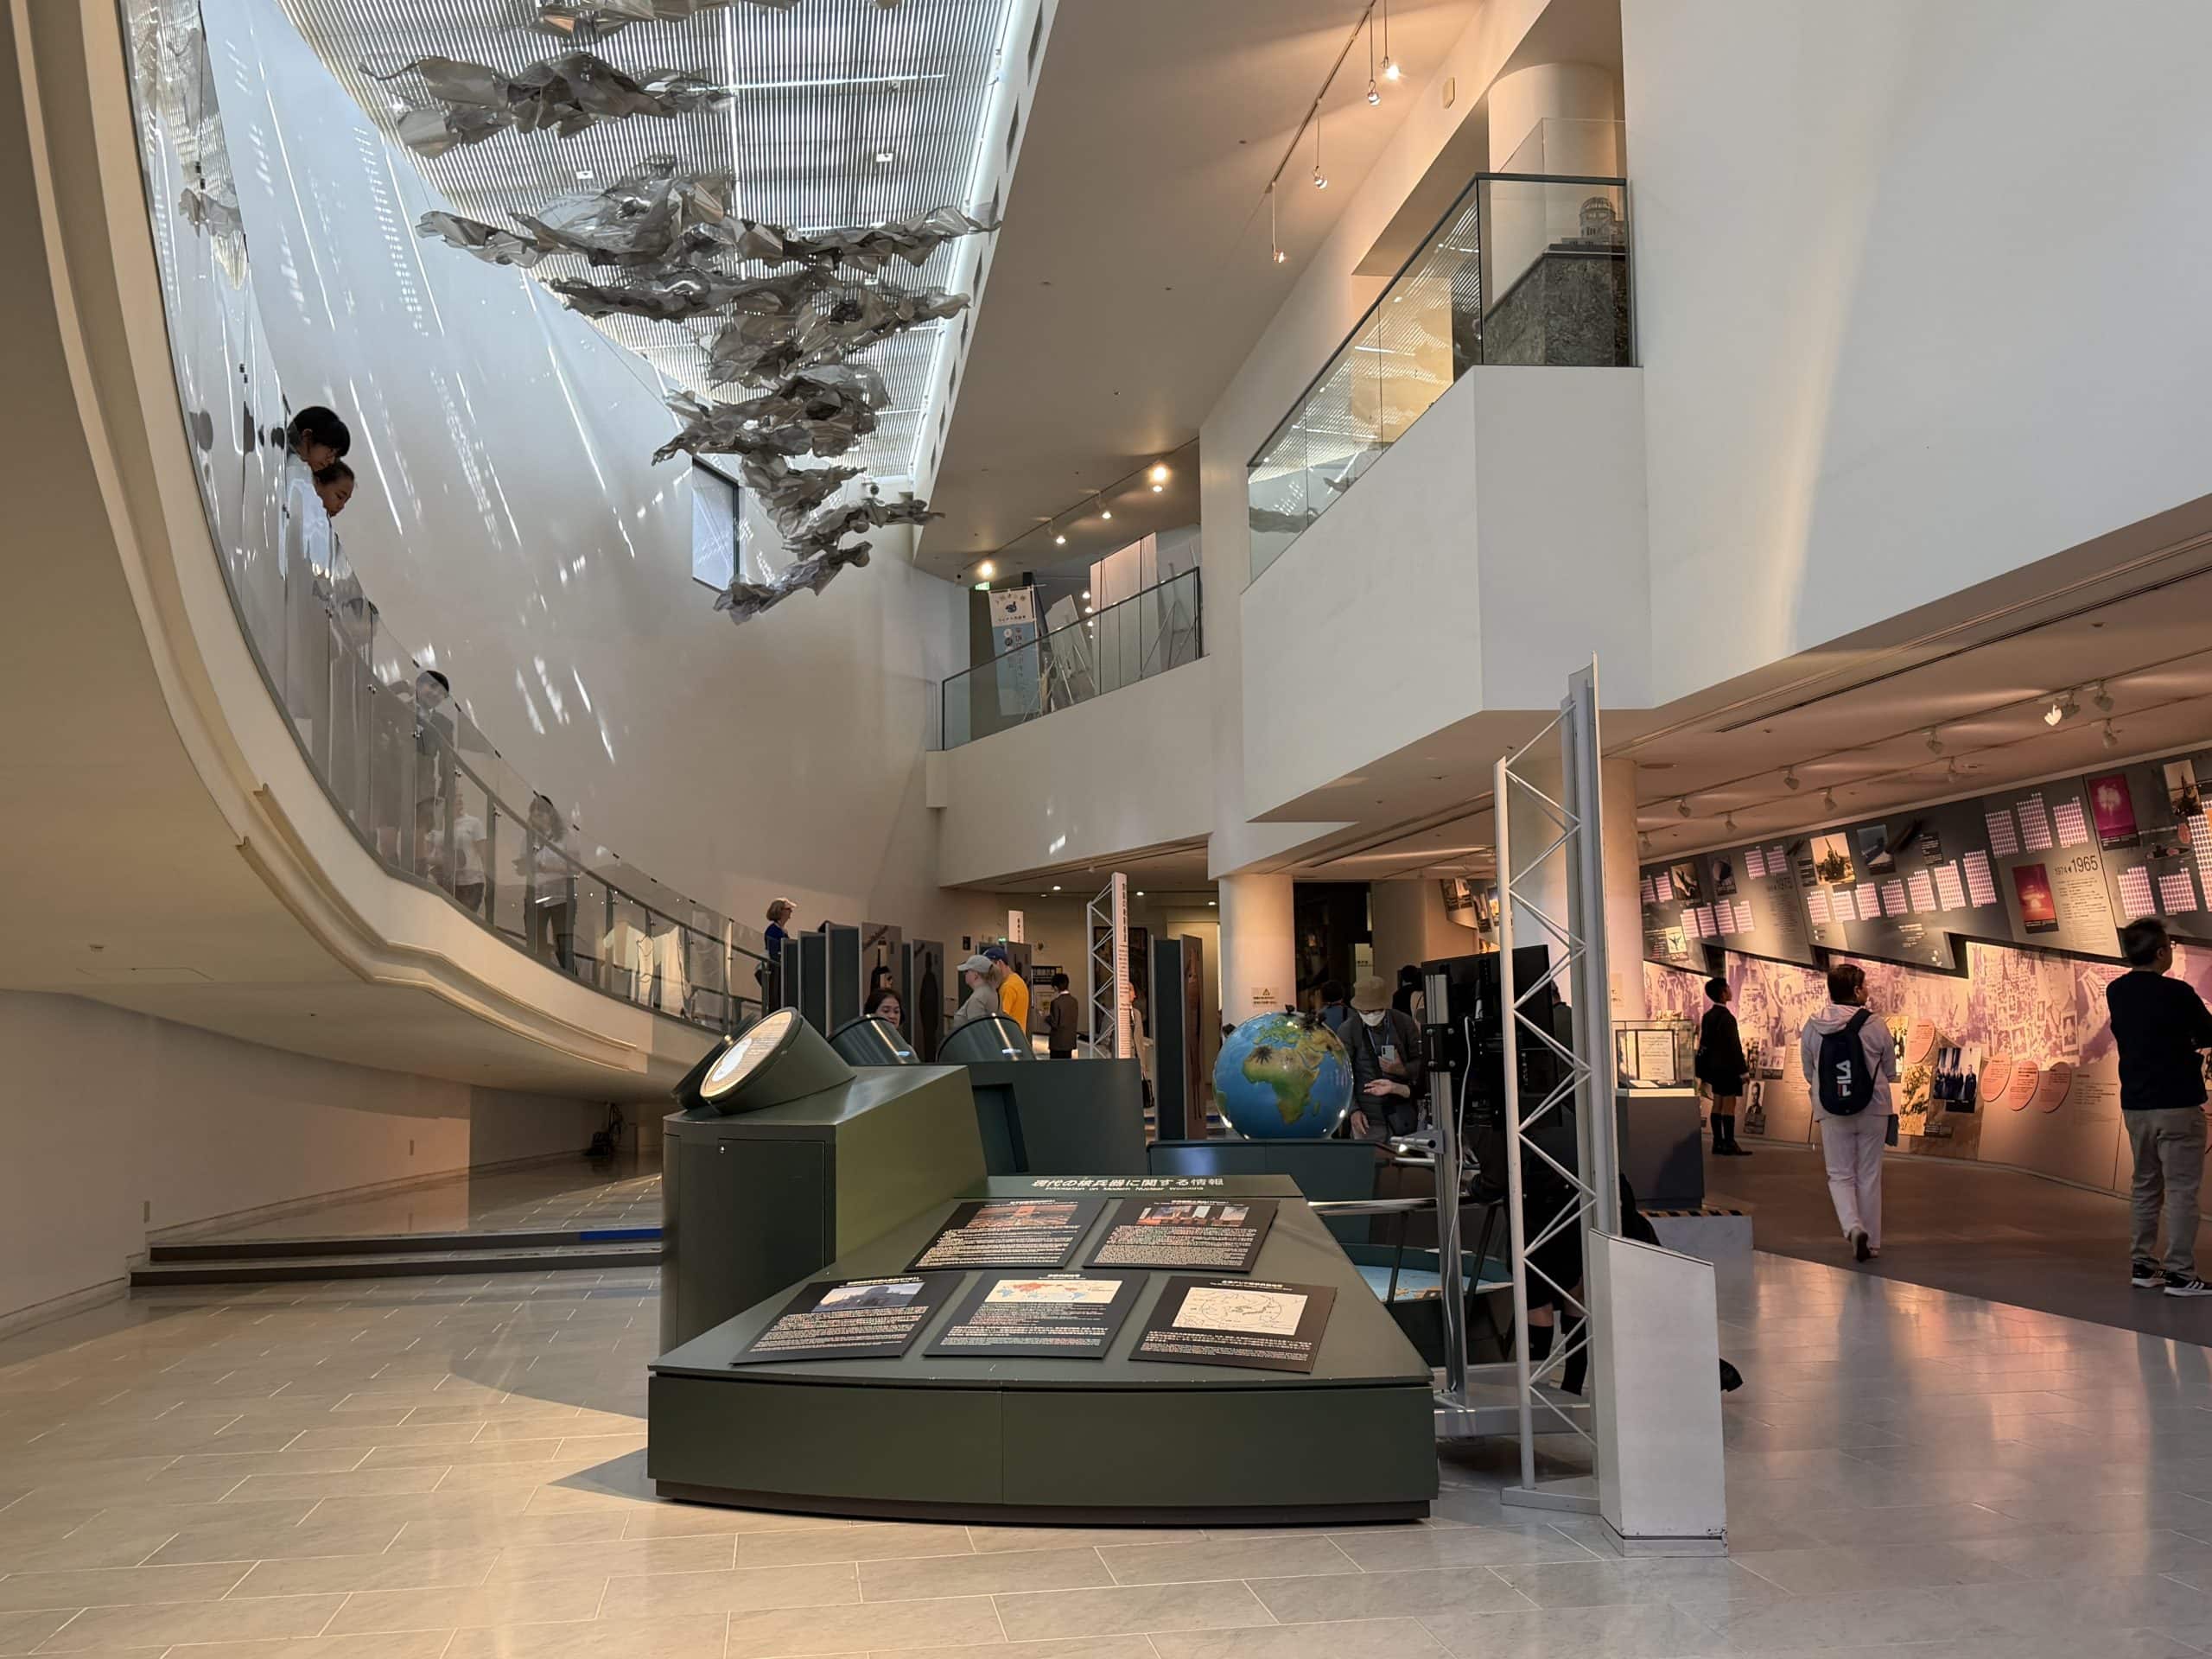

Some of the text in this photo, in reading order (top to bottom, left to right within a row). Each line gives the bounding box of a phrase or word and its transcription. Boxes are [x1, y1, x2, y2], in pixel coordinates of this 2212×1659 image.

[2071, 855, 2099, 874] 1965
[1836, 1059, 1852, 1097] FILA
[1031, 1178, 1224, 1188] 現代の核兵器に関する情報
